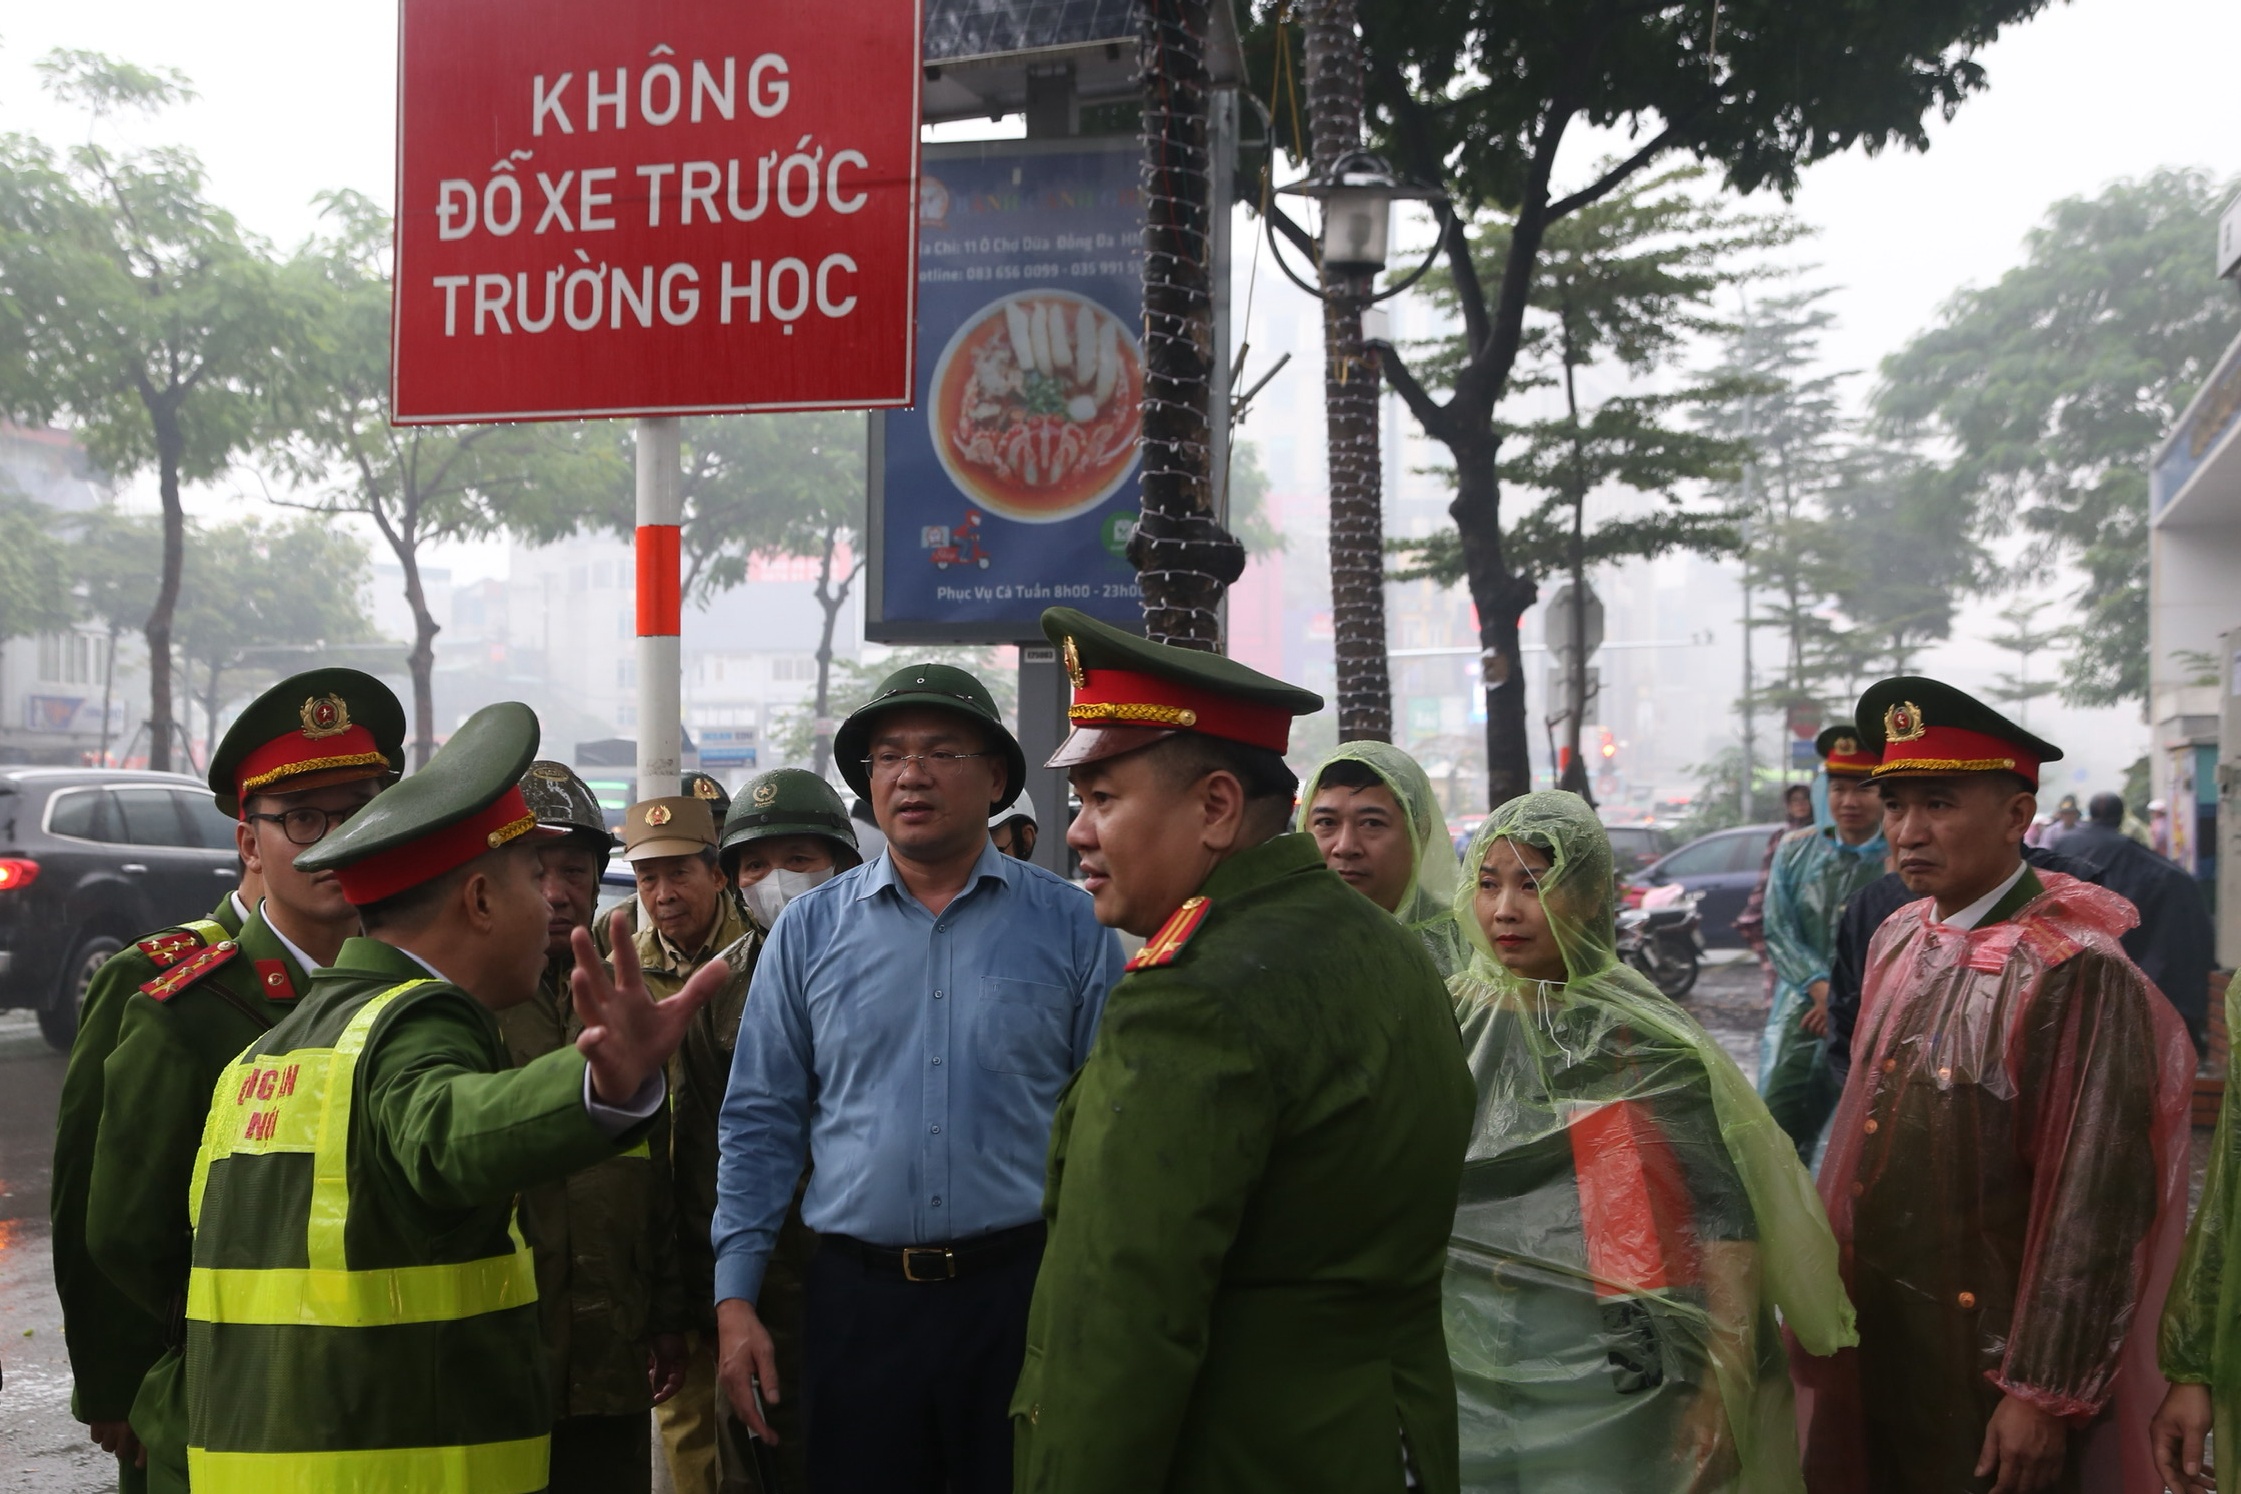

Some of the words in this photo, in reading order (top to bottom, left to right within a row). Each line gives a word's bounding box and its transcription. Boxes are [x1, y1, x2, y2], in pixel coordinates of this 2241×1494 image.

[531, 43, 790, 137] KHÔNG
[435, 149, 533, 241] ĐỖ
[534, 167, 617, 235] XE
[636, 134, 869, 228] TRƯỚC
[433, 248, 700, 337] TRƯỜNG
[720, 252, 858, 336] HỌC
[918, 268, 962, 282] otline:
[937, 586, 971, 604] Phục
[974, 586, 992, 604] Vụ
[1054, 584, 1090, 598] 8h00
